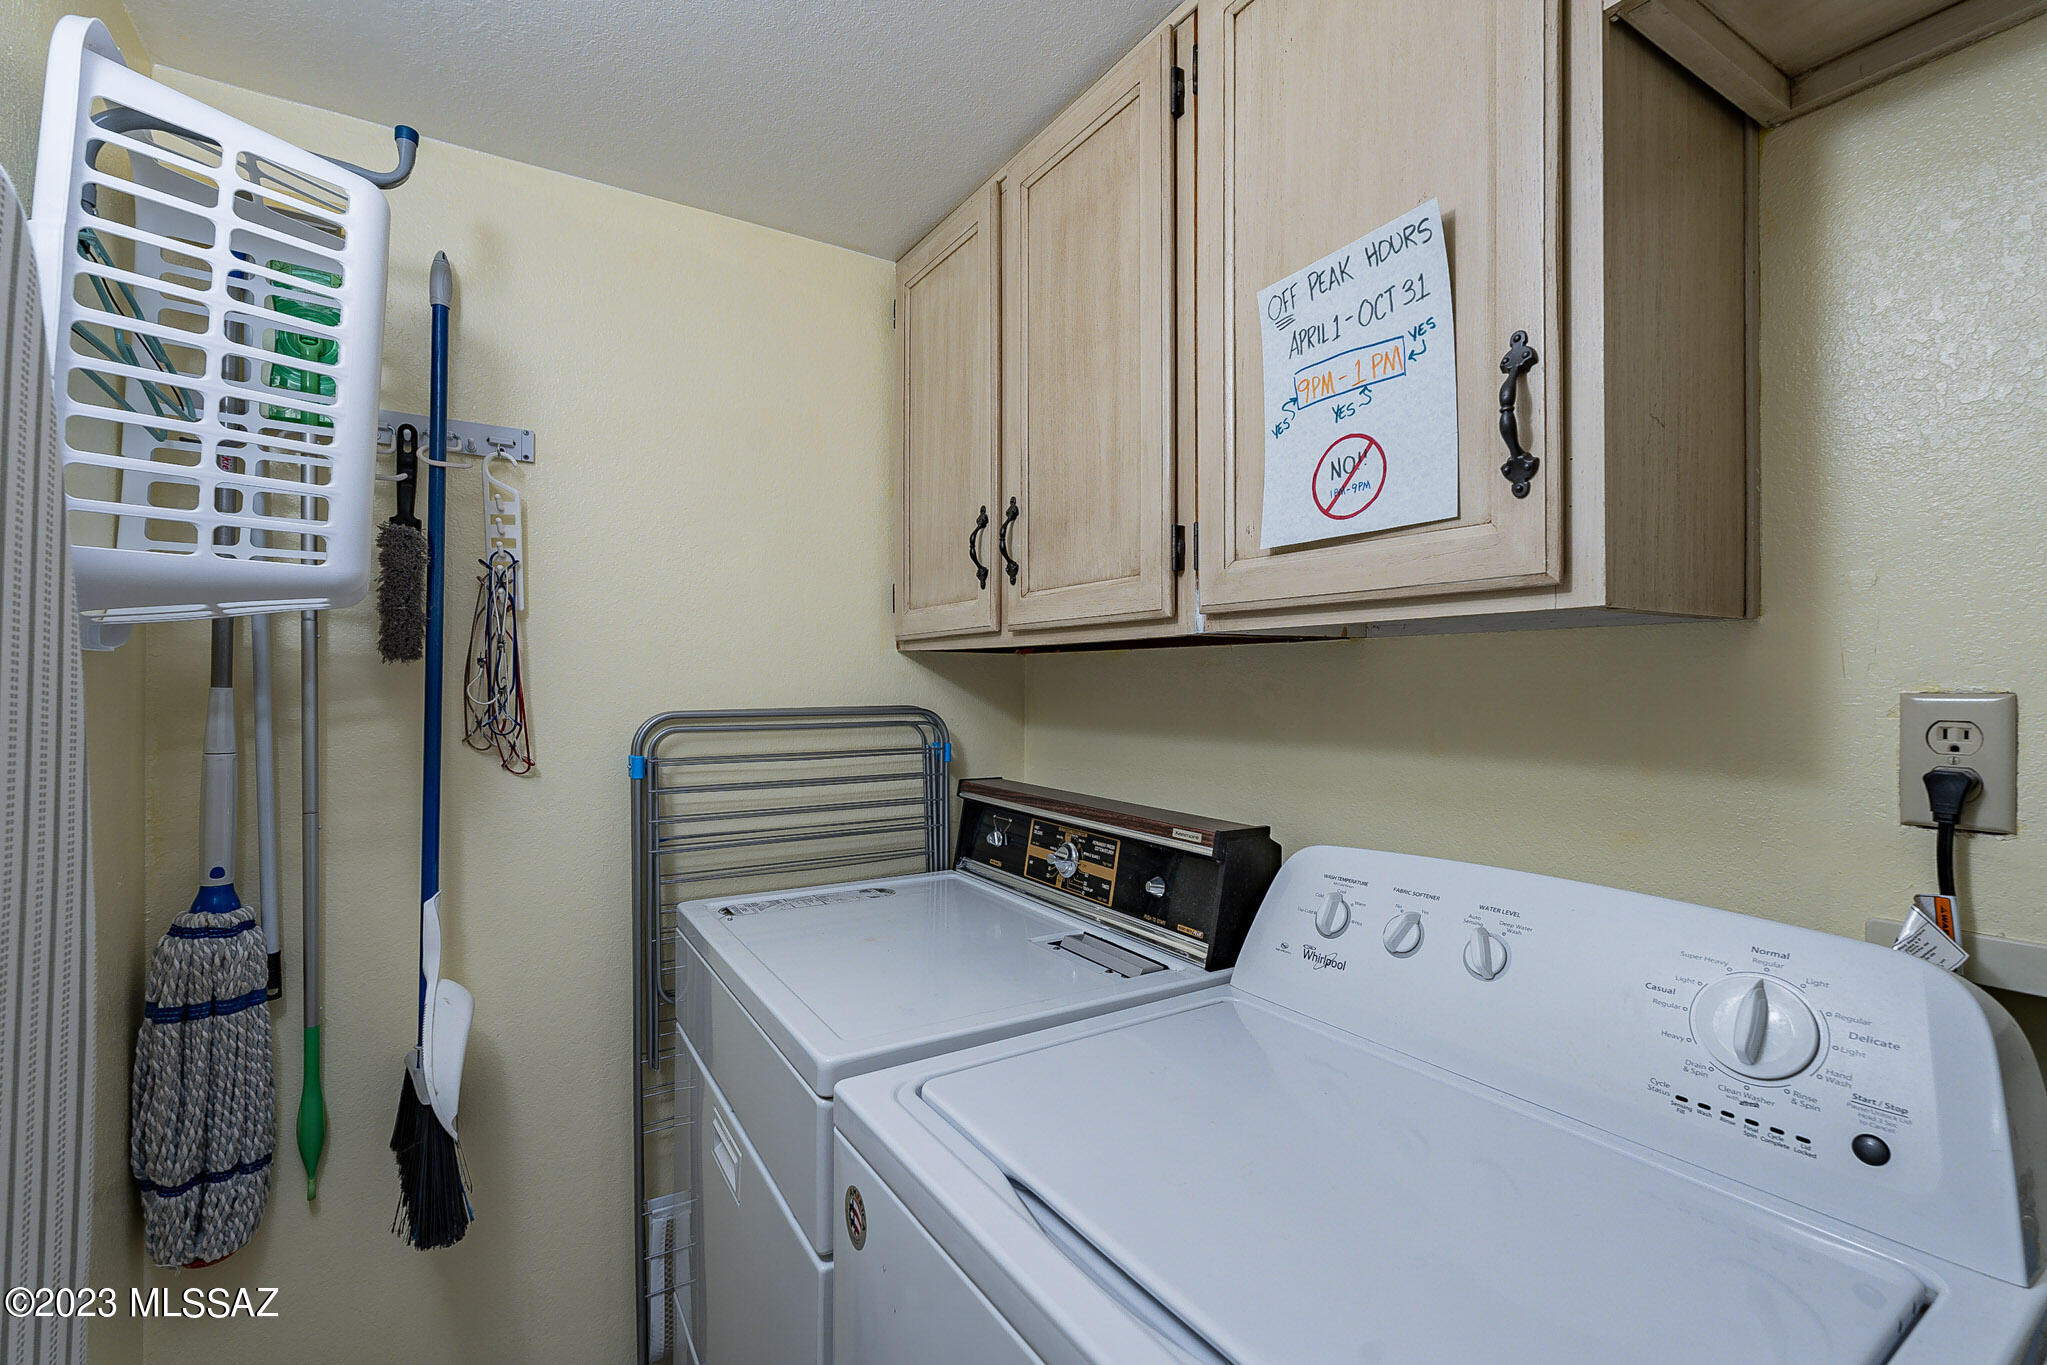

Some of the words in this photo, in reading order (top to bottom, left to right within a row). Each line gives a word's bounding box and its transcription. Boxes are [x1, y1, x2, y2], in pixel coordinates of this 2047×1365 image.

[1267, 282, 1298, 321] OFF
[1307, 255, 1354, 300] PEAK
[1365, 217, 1433, 267] HOURS
[1358, 285, 1396, 327] OCT
[1401, 273, 1431, 306] 31
[1408, 316, 1437, 341] YES
[1297, 370, 1336, 404] 9PM
[1332, 402, 1355, 423] YES
[1271, 417, 1290, 439] YES
[1324, 873, 1337, 881] WASH
[1337, 876, 1369, 887] TEMPERATURE
[1393, 887, 1412, 896] FABRIC
[1412, 891, 1441, 901] SOFTENER
[1479, 904, 1501, 914] WATER
[1502, 909, 1521, 918] LEVEL
[1499, 921, 1514, 929] Deep
[1515, 924, 1533, 932] Water
[1303, 948, 1347, 971] Whirlpool
[1680, 951, 1703, 962] Super
[1705, 956, 1729, 967] Heavy
[1751, 946, 1791, 960] Normal
[1752, 957, 1784, 969] Regular
[1675, 975, 1695, 985] Light
[1805, 977, 1829, 988] Light
[1645, 982, 1676, 995] Casual
[1652, 998, 1682, 1010] Regular
[1834, 1012, 1872, 1026] Regular
[1661, 1030, 1685, 1042] Heavy
[1848, 1031, 1901, 1051] Delicate
[1840, 1046, 1867, 1058] Light
[1685, 1058, 1706, 1070] Drain
[1689, 1067, 1709, 1079] Spin
[1825, 1068, 1853, 1081] Hand
[1650, 1077, 1670, 1089] Cycle
[1825, 1076, 1852, 1088] Wash
[1647, 1084, 1670, 1097] Status
[1718, 1084, 1742, 1097] Clean
[1743, 1092, 1775, 1107] Washer
[1793, 1090, 1818, 1103] Rinse
[1670, 1100, 1693, 1113] Sensing
[1797, 1099, 1822, 1113] Spin
[1852, 1093, 1877, 1106] Start
[1885, 1102, 1909, 1115] Stop
[1676, 1107, 1686, 1115] Fill
[1697, 1109, 1713, 1118] Wash
[1720, 1117, 1736, 1126] Rinse
[1743, 1124, 1759, 1134] Final
[1743, 1131, 1758, 1140] Spin
[1760, 1136, 1790, 1150] Complete
[1767, 1133, 1784, 1143] Cycle
[1800, 1143, 1812, 1151] Lid
[1794, 1148, 1817, 1160] Locked
